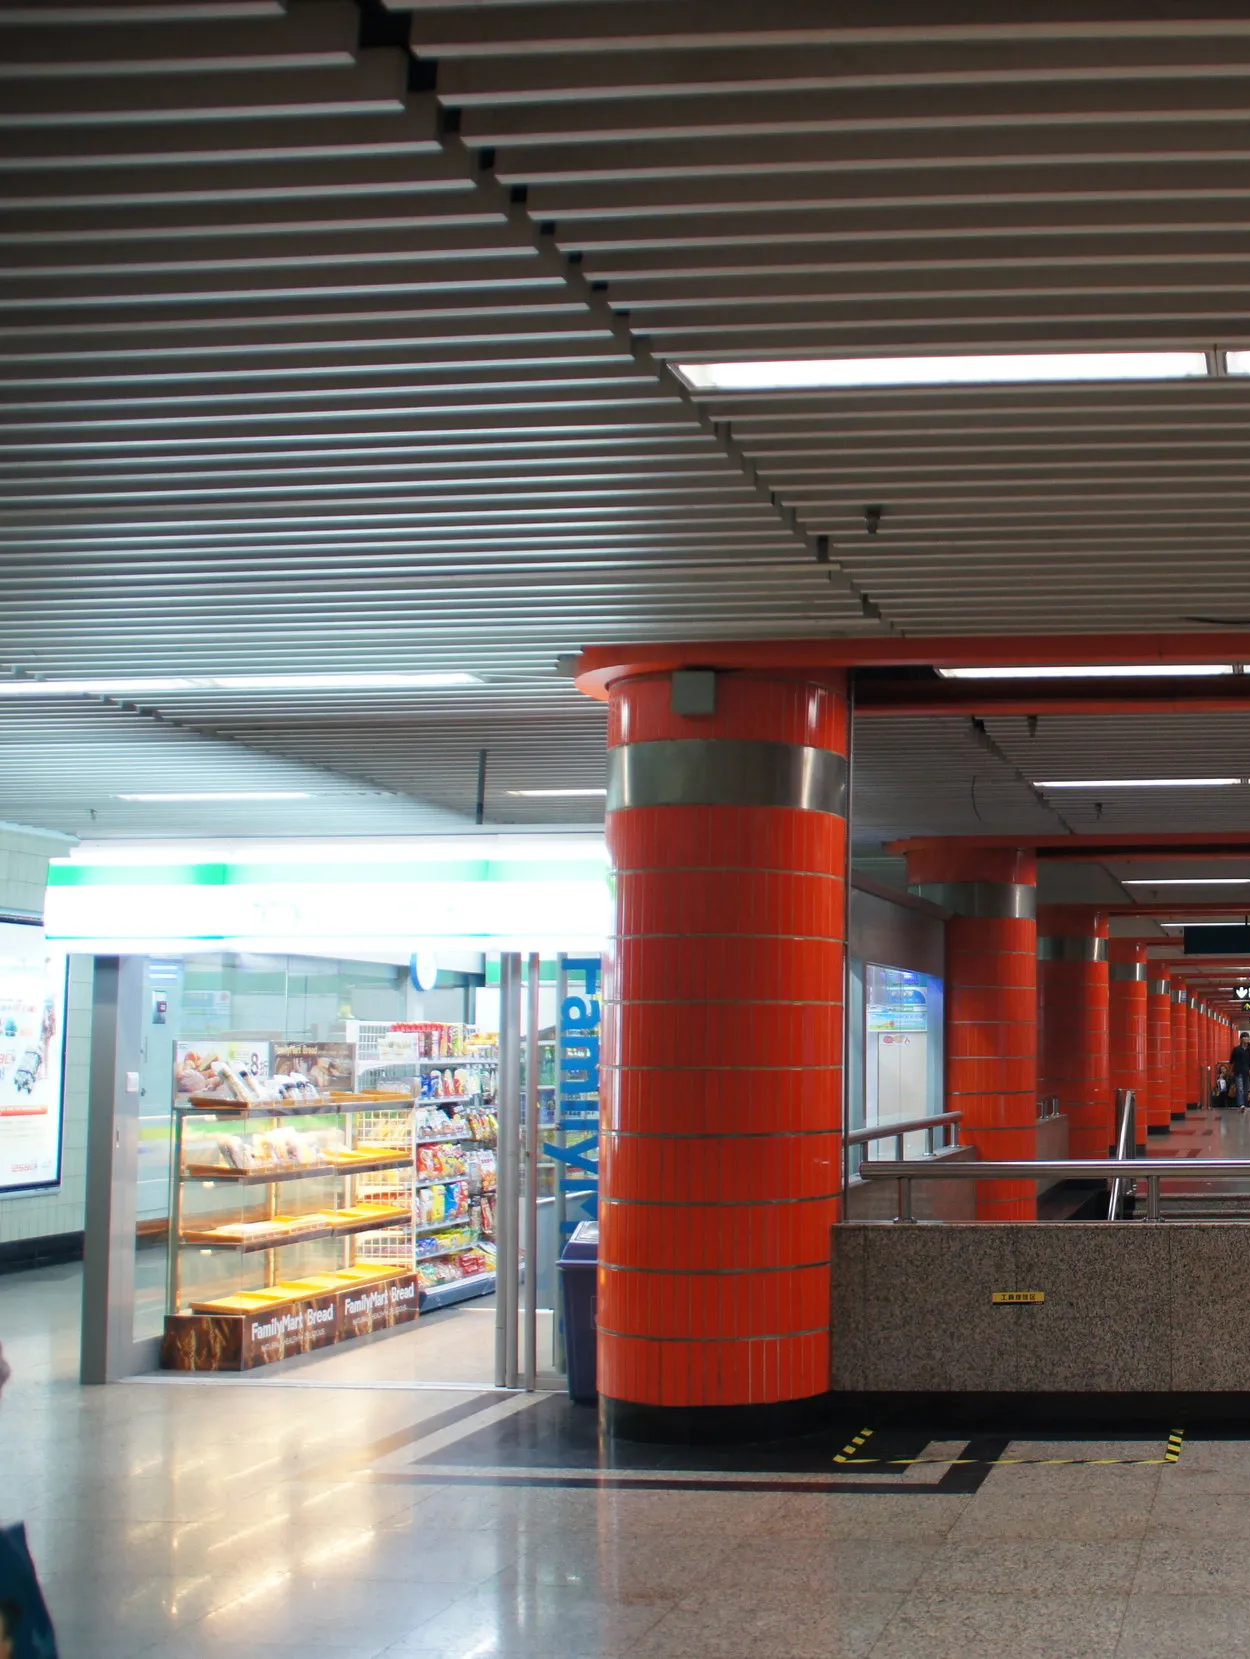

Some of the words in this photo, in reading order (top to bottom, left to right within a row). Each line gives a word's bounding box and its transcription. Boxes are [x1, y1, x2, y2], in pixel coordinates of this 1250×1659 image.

[543, 958, 602, 1252] FamilyM
[345, 1290, 388, 1315] FamilyMart
[391, 1282, 414, 1304] Bread
[252, 1312, 303, 1341] FamilyMart
[307, 1303, 334, 1326] Bread
